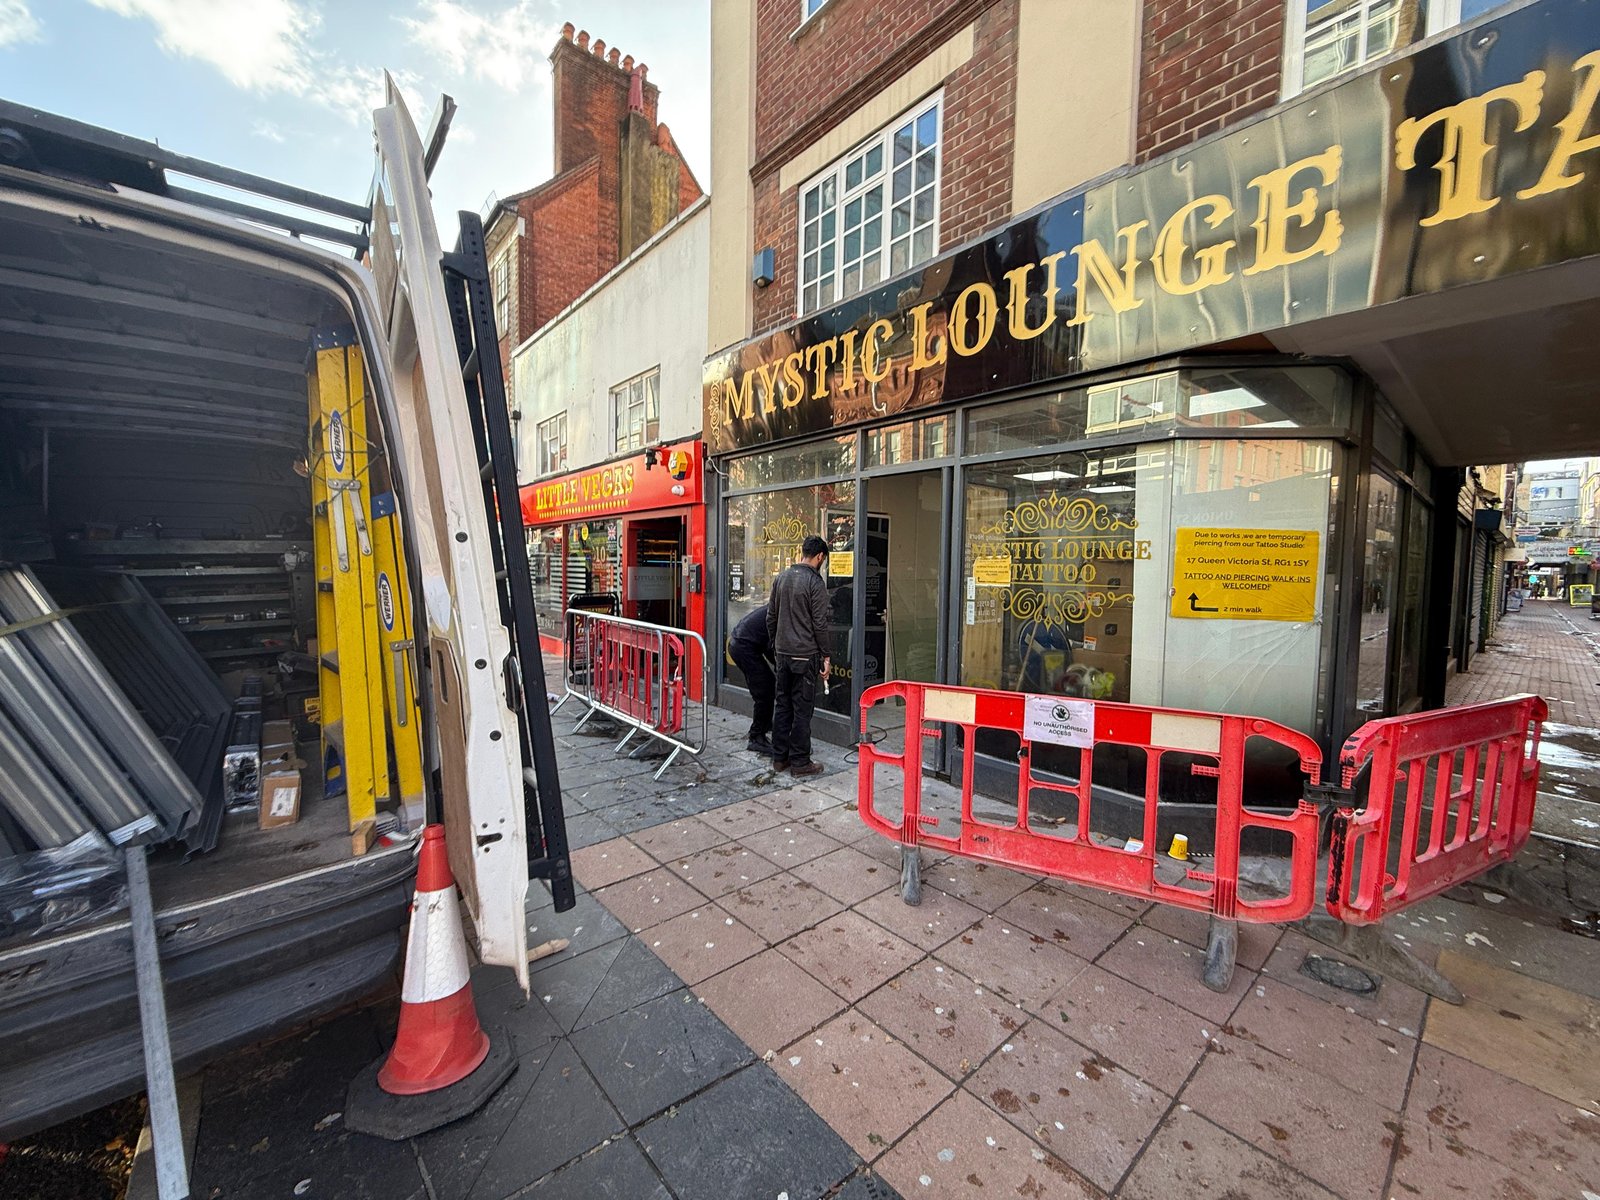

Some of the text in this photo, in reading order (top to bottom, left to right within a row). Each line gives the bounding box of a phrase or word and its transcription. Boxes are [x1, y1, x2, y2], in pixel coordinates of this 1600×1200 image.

[723, 319, 894, 425] MYSTIC
[907, 145, 1344, 372] LOUNGE
[333, 419, 342, 460] WERNER
[535, 463, 634, 511] LITTLE VEGAS
[1268, 533, 1306, 541] temporary
[971, 541, 1046, 560] MYSTIC
[1050, 540, 1152, 560] LOUNGE
[1227, 557, 1260, 566] Victoria
[1274, 558, 1291, 566] RG1
[1293, 559, 1309, 567] 1SY
[1010, 563, 1097, 583] TATTOO
[1271, 575, 1311, 583] WALK-INS
[382, 584, 392, 620] WERNER
[1043, 722, 1088, 733] UNAUTHORISED
